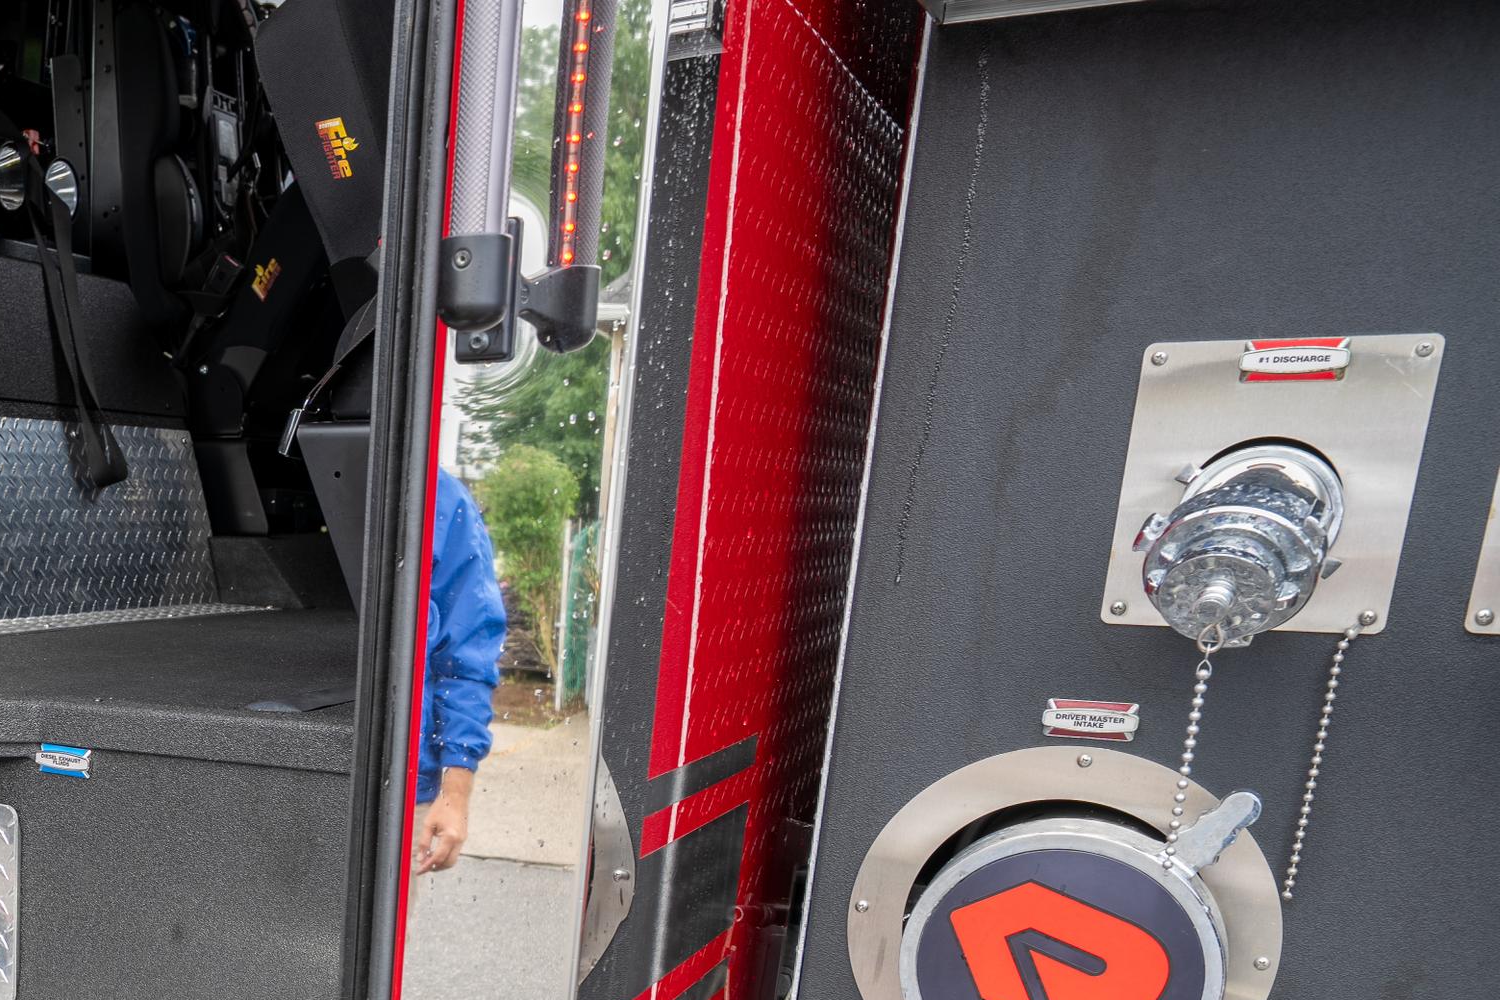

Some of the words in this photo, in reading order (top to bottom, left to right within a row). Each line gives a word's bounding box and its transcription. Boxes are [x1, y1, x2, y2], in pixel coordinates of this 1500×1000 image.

[1273, 354, 1332, 364] DISCHARGE
[1055, 713, 1088, 722] DRIVER
[1088, 715, 1126, 724] MASTER
[1073, 720, 1105, 729] INTAKE
